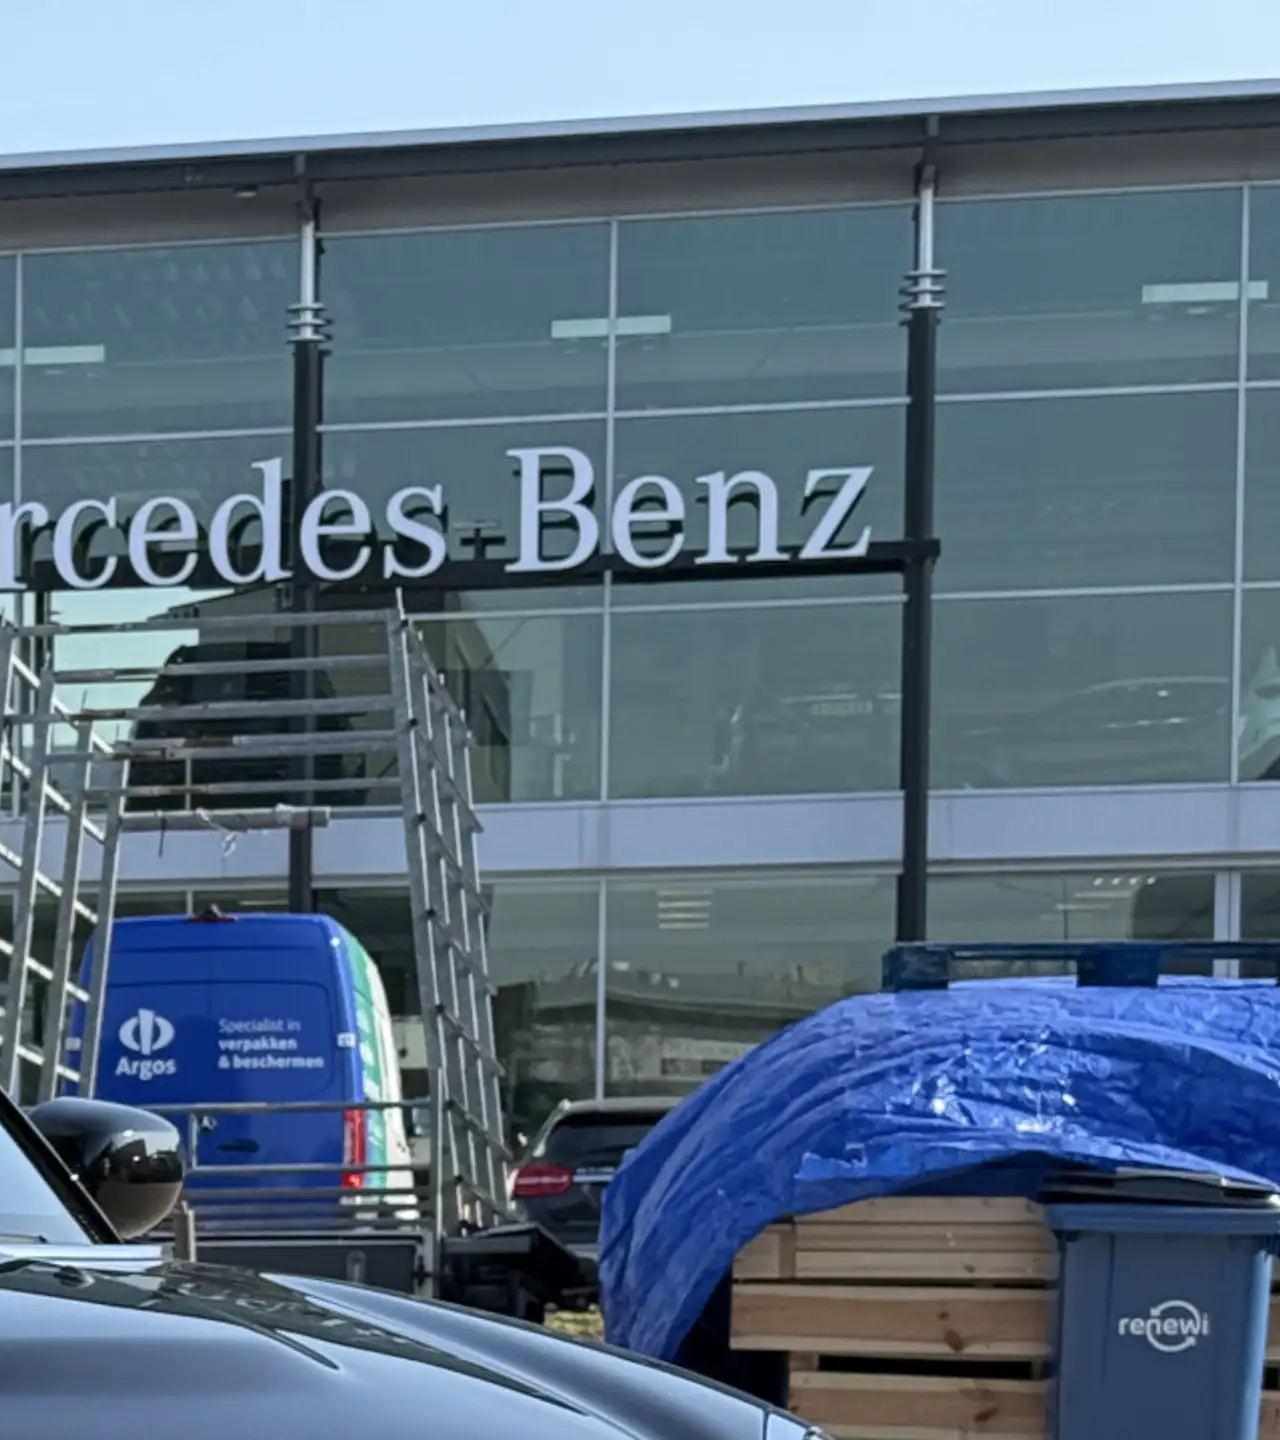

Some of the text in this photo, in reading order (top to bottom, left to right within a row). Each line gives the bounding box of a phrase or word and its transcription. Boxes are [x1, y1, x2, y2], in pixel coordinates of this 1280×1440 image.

[218, 1018, 301, 1034] Specialist in
[218, 1037, 299, 1052] verpakken
[114, 1056, 178, 1082] Argos
[217, 1053, 325, 1069] & beschermen
[1117, 1310, 1210, 1339] renewi
